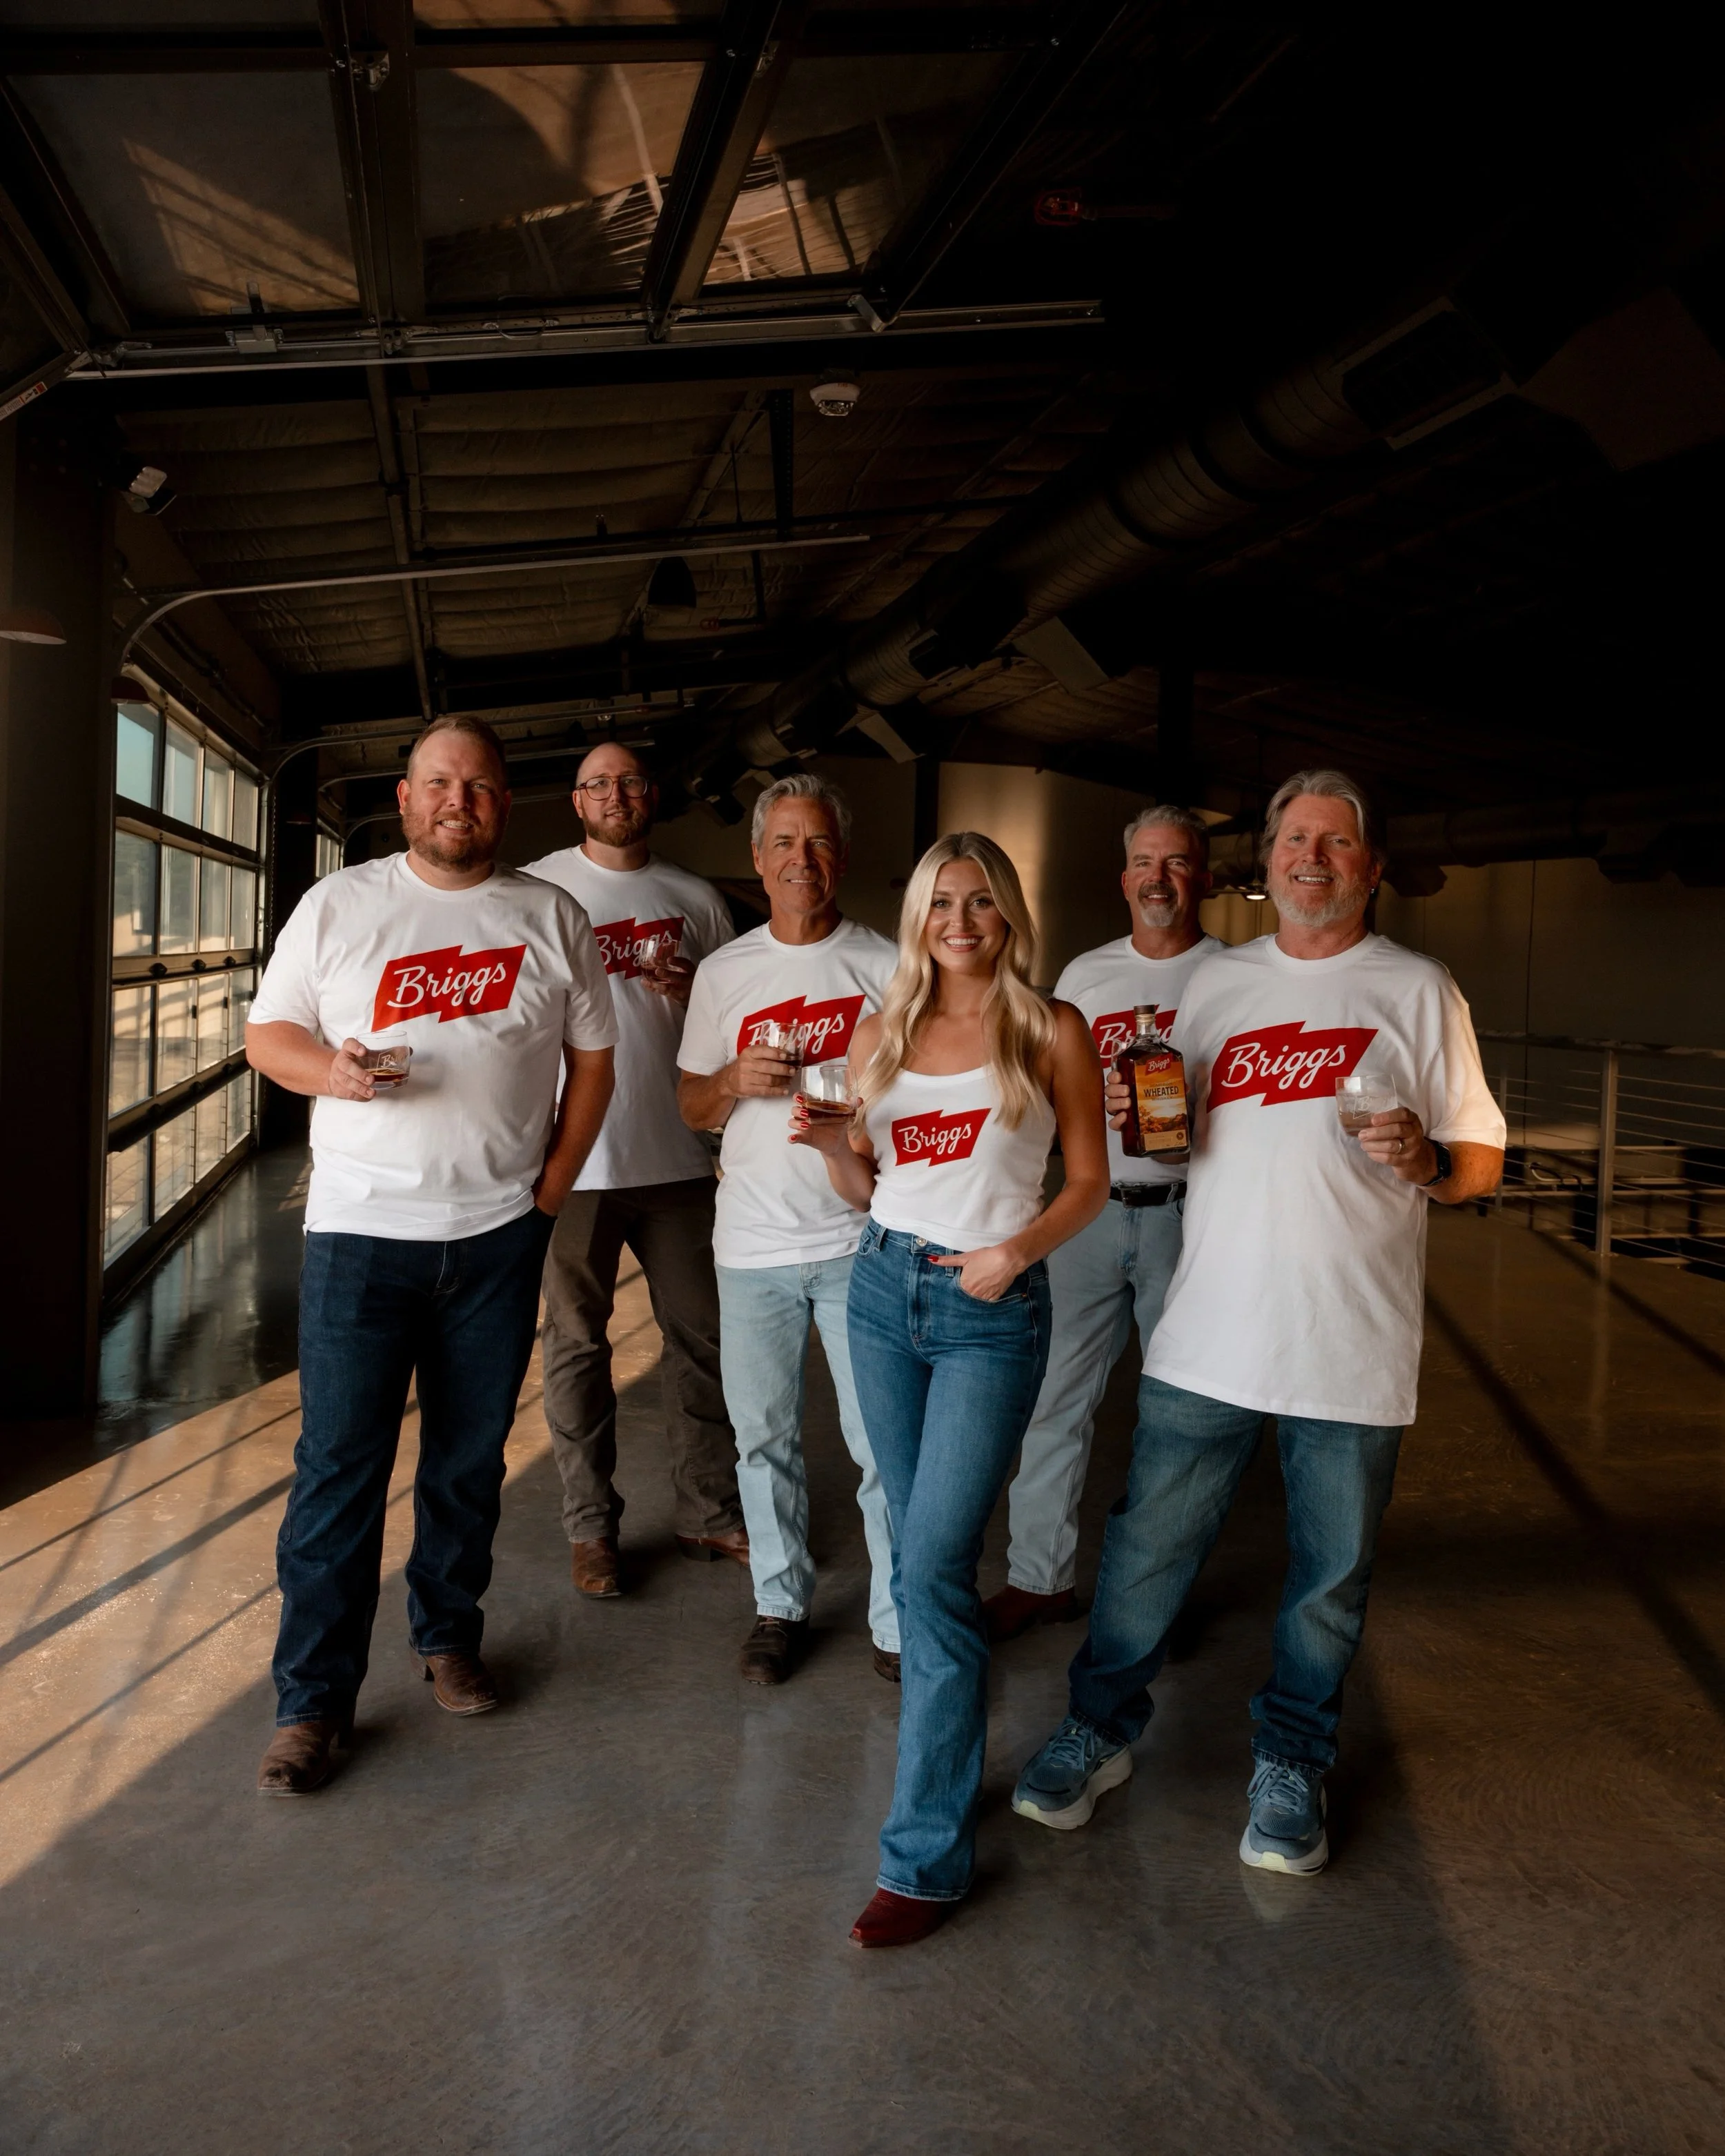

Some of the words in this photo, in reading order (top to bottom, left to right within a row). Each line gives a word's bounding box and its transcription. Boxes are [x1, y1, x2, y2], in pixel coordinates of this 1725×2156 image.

[386, 962, 506, 1007] Briggs
[1147, 1058, 1170, 1071] Briggs
[1221, 1044, 1347, 1090] Briggs
[1143, 1086, 1179, 1098] WHEATED
[898, 1123, 972, 1155] Briggs
